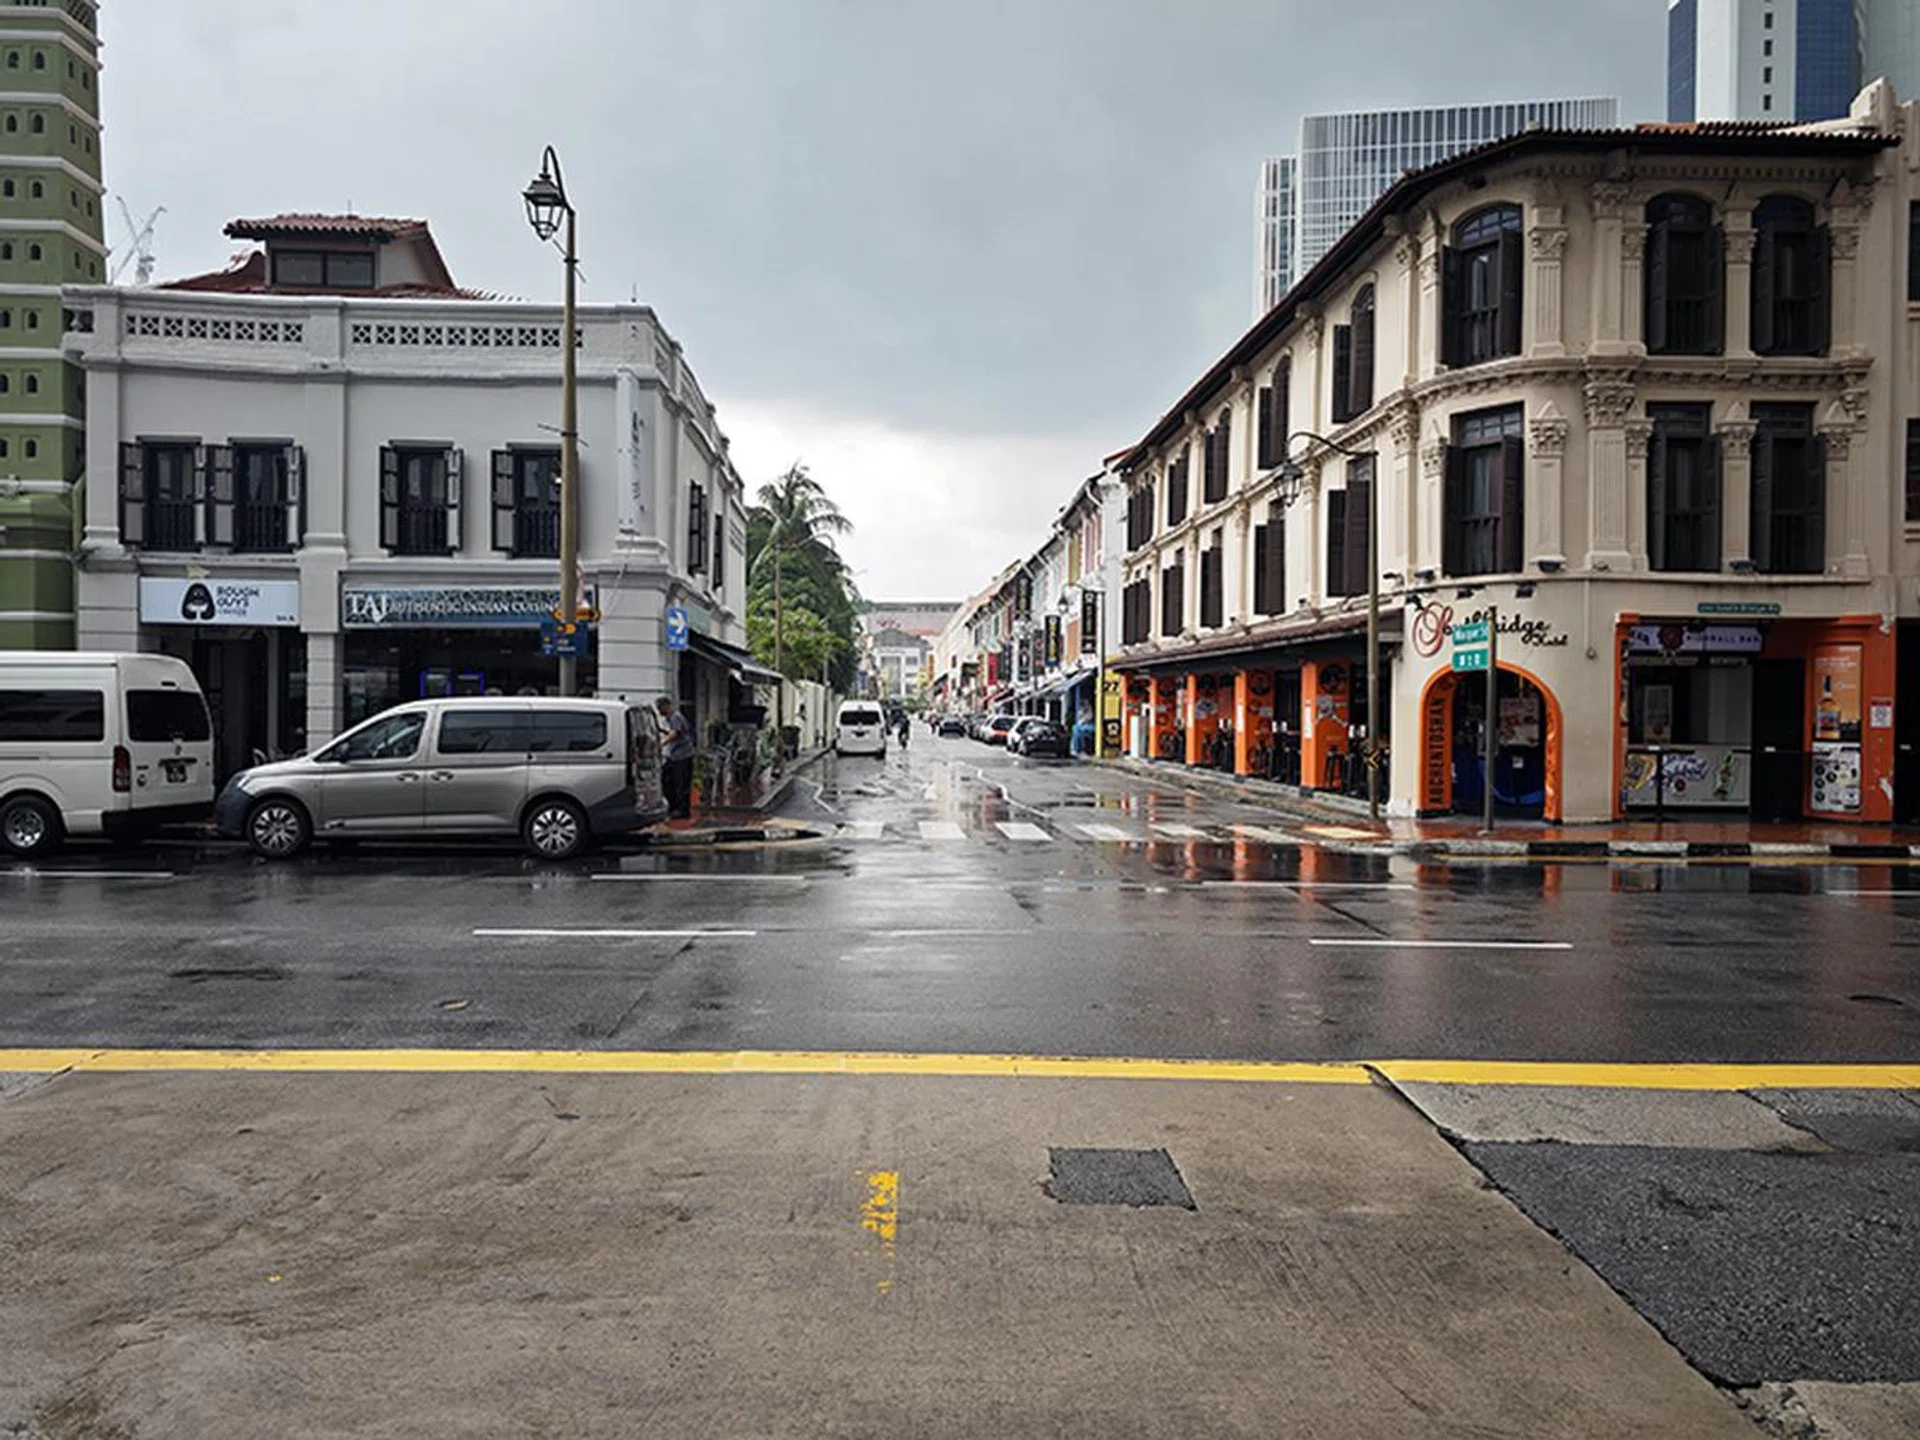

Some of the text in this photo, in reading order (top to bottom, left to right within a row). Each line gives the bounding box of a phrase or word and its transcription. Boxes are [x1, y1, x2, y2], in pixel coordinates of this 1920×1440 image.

[217, 586, 259, 597] ROUGH
[345, 593, 387, 622] TAJ
[463, 600, 509, 613] INDIAN
[1429, 698, 1444, 804] AUCHENTOSHAN
